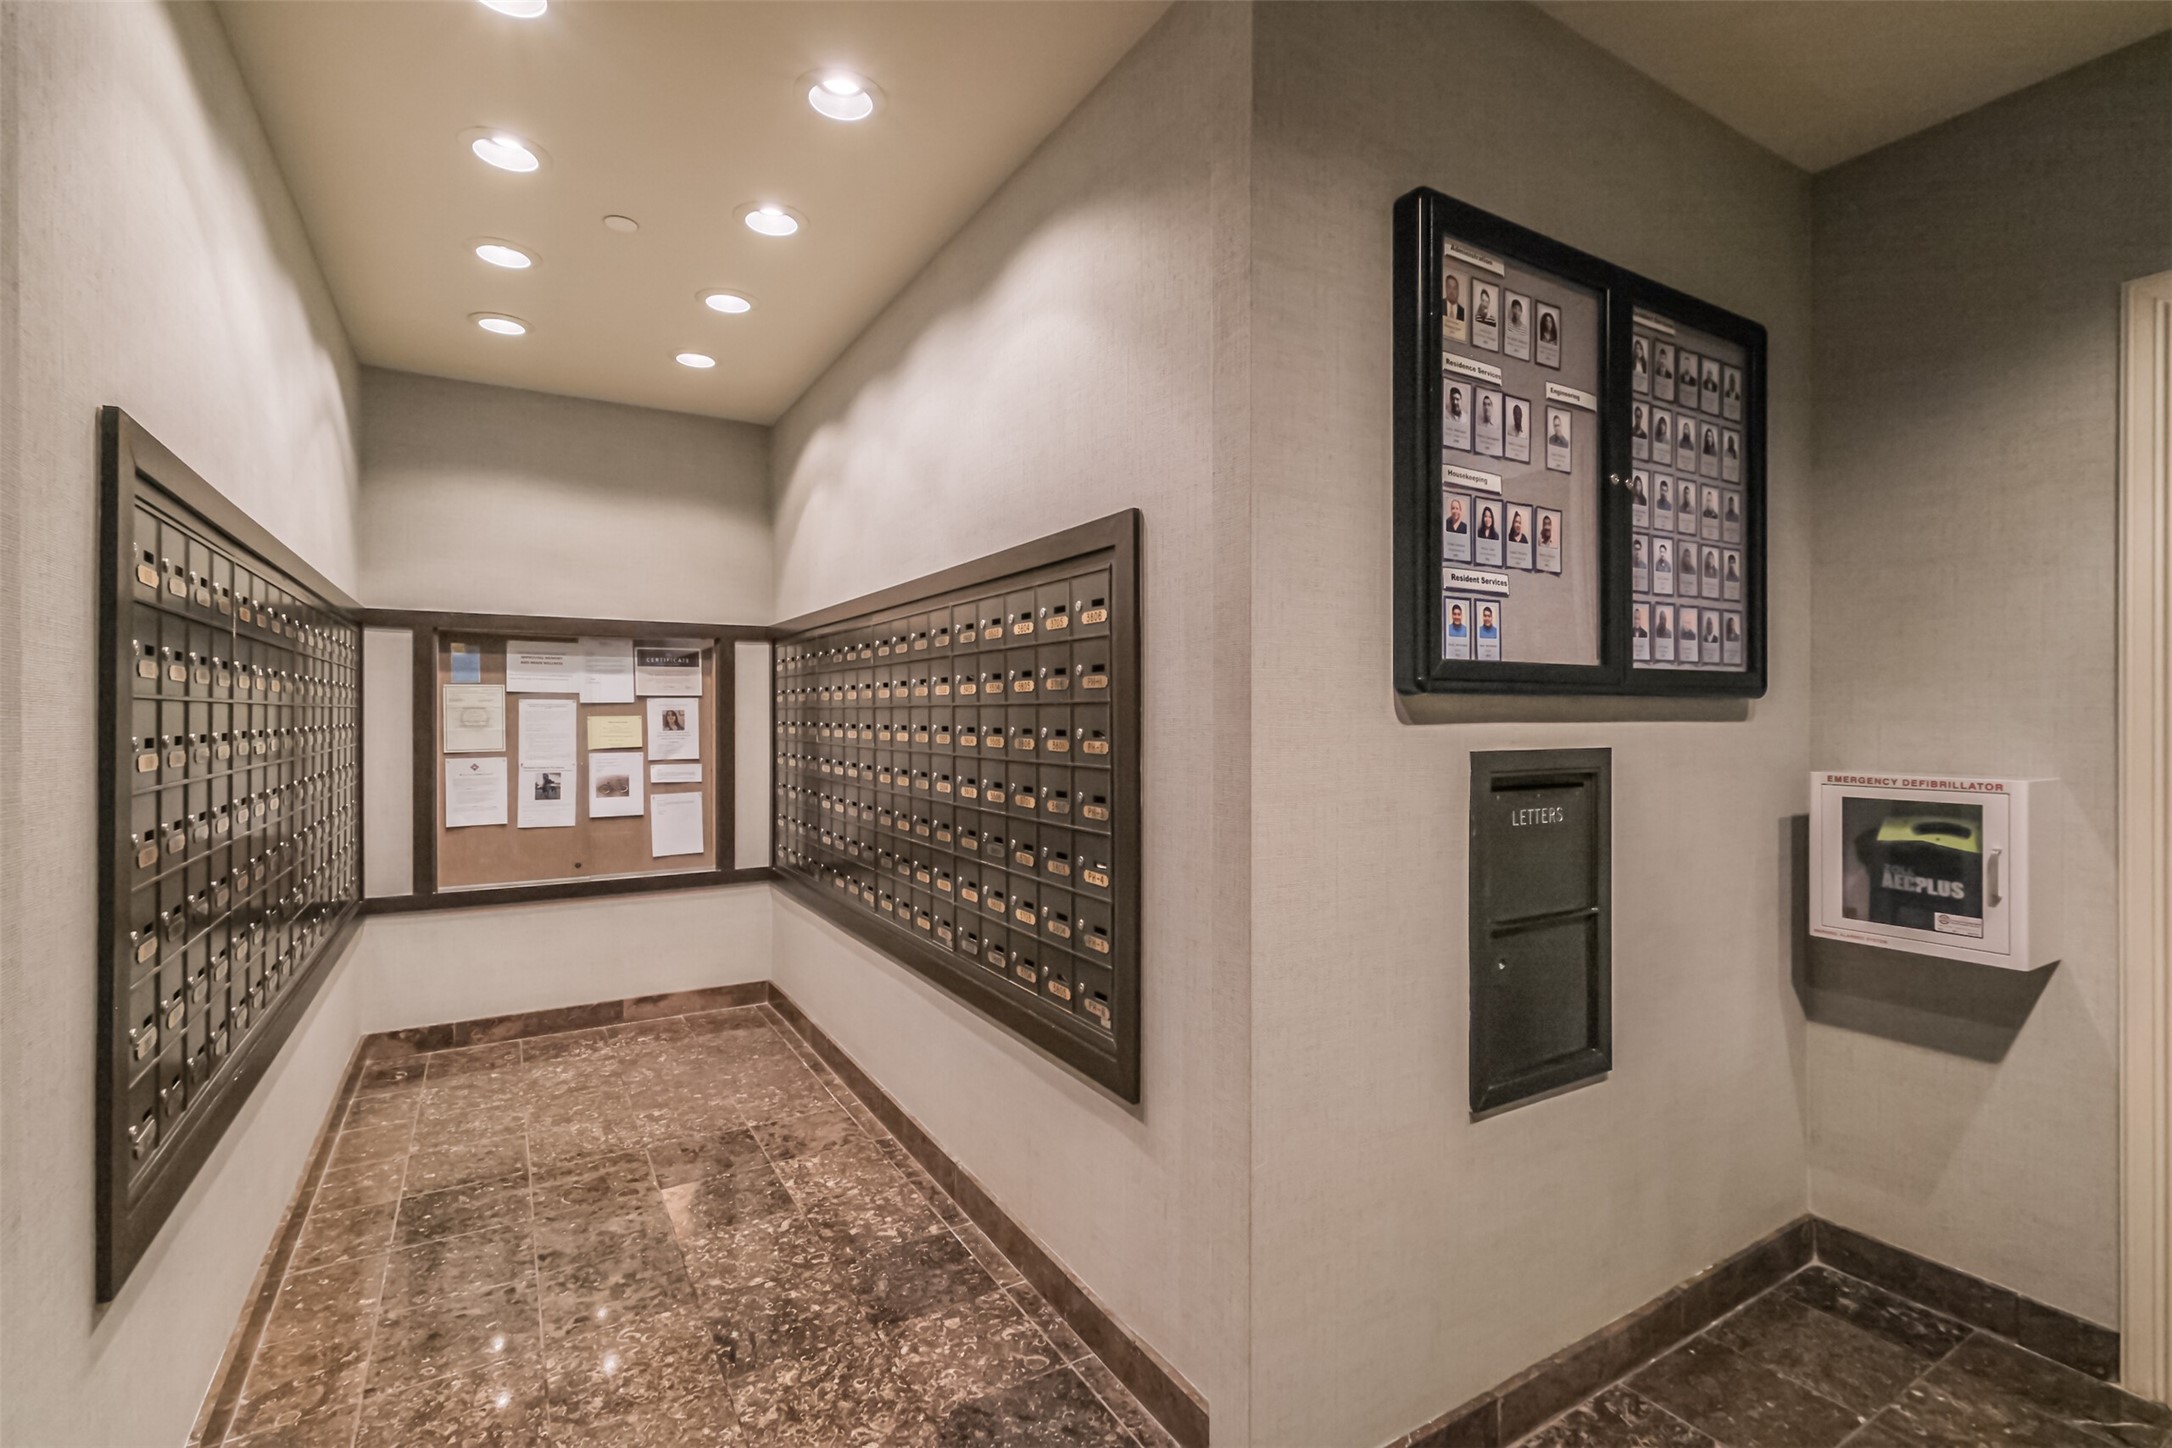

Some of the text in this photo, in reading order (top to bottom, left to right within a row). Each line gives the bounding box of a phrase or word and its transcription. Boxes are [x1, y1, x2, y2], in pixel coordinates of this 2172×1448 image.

[1445, 357, 1502, 381] Residence Services
[1550, 387, 1581, 402] Engineering
[1447, 469, 1488, 485] Housekeeping
[1450, 573, 1508, 587] Resident Services
[1826, 775, 2004, 791] EMERGENCY DEFIBRILLATOR
[1512, 807, 1564, 826] LETTERS
